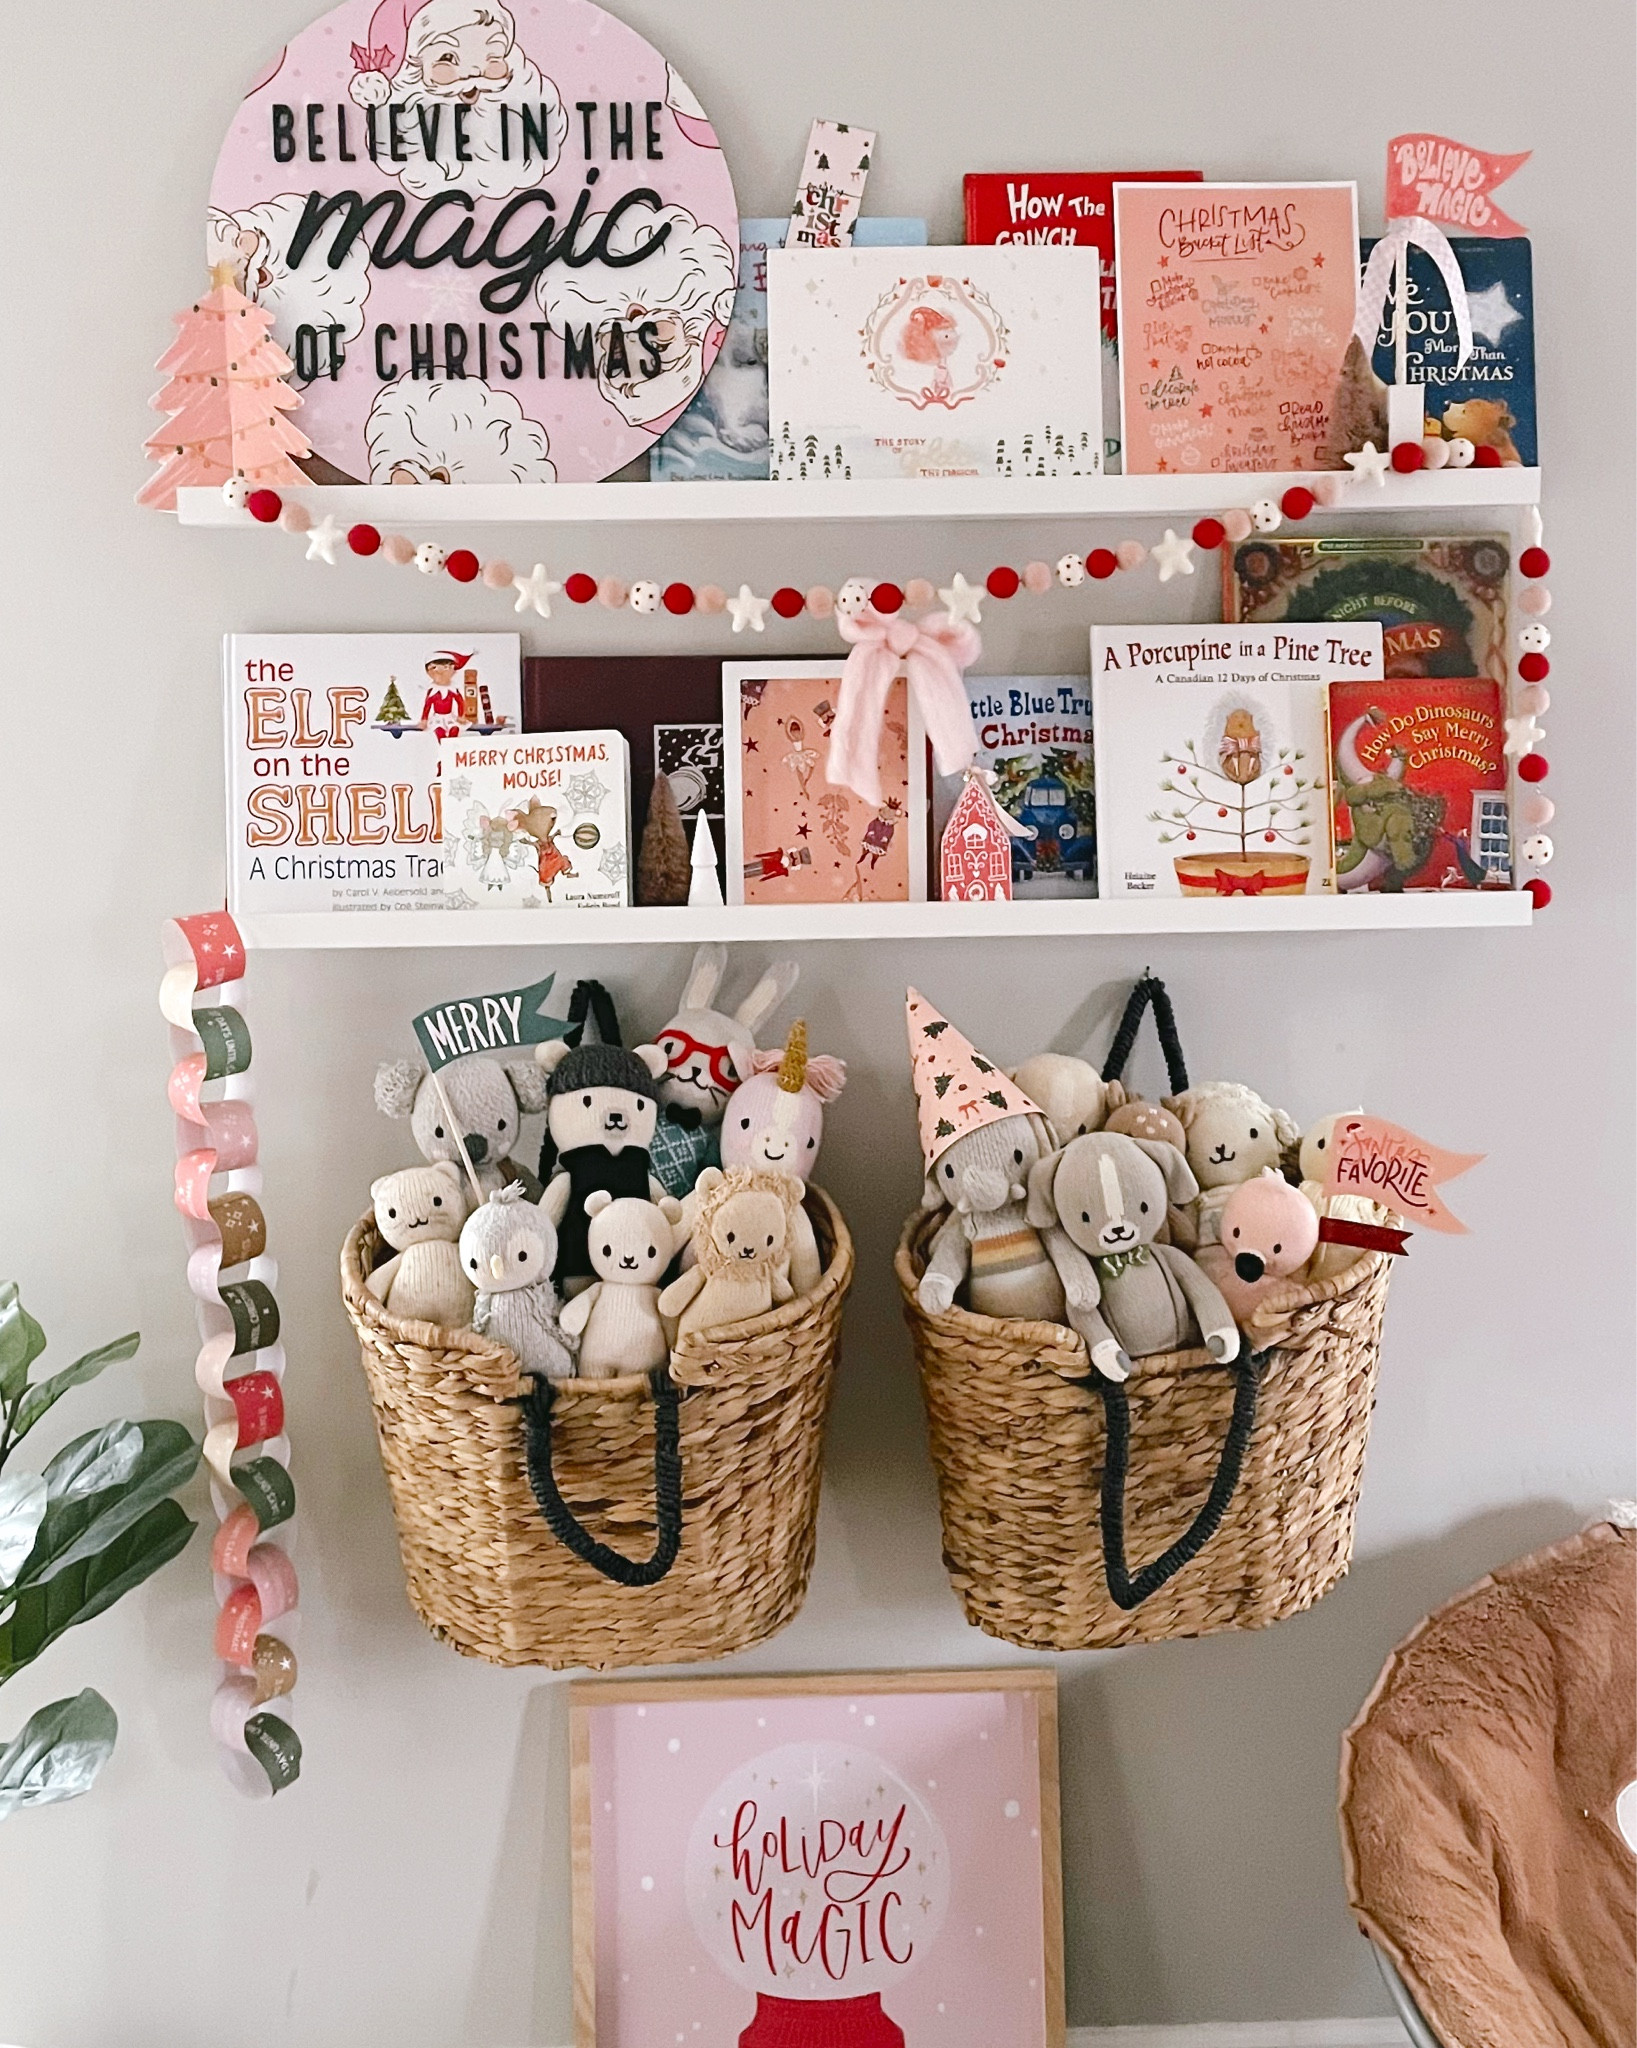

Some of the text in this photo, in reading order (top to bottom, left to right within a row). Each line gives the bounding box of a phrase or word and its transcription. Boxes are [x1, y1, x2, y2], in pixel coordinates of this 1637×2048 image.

[272, 101, 664, 162] BELIEVE IN THE
[1068, 196, 1106, 218] The
[1416, 182, 1491, 227] MAGIC
[995, 227, 1077, 246] GRINCH
[1159, 203, 1296, 248] CHRISTMAS
[285, 167, 672, 314] magic
[295, 321, 662, 382] OF CHRISTMAS
[1424, 338, 1459, 354] Mor
[1469, 346, 1506, 360] Than
[1373, 595, 1418, 615] BEFORE
[1103, 635, 1372, 672] A Porcupine in a Pine Tree
[245, 659, 294, 682] the
[1155, 672, 1321, 684] A Canadian 12 Days of Christmas
[1008, 689, 1055, 716] Blue
[244, 687, 369, 750] ELF
[1362, 705, 1494, 762] How Do Dinosaurs
[1411, 722, 1493, 751] Say Merry
[253, 753, 350, 777] on the
[455, 743, 610, 768] MERRY CHRISTMAS,
[1408, 743, 1497, 774] Christmas?
[503, 769, 561, 790] MOUSE!
[249, 855, 444, 881] A Christmas Tra
[215, 1016, 232, 1039] DAYS
[423, 995, 522, 1061] MERRY
[1337, 1153, 1429, 1207] FAVORITE
